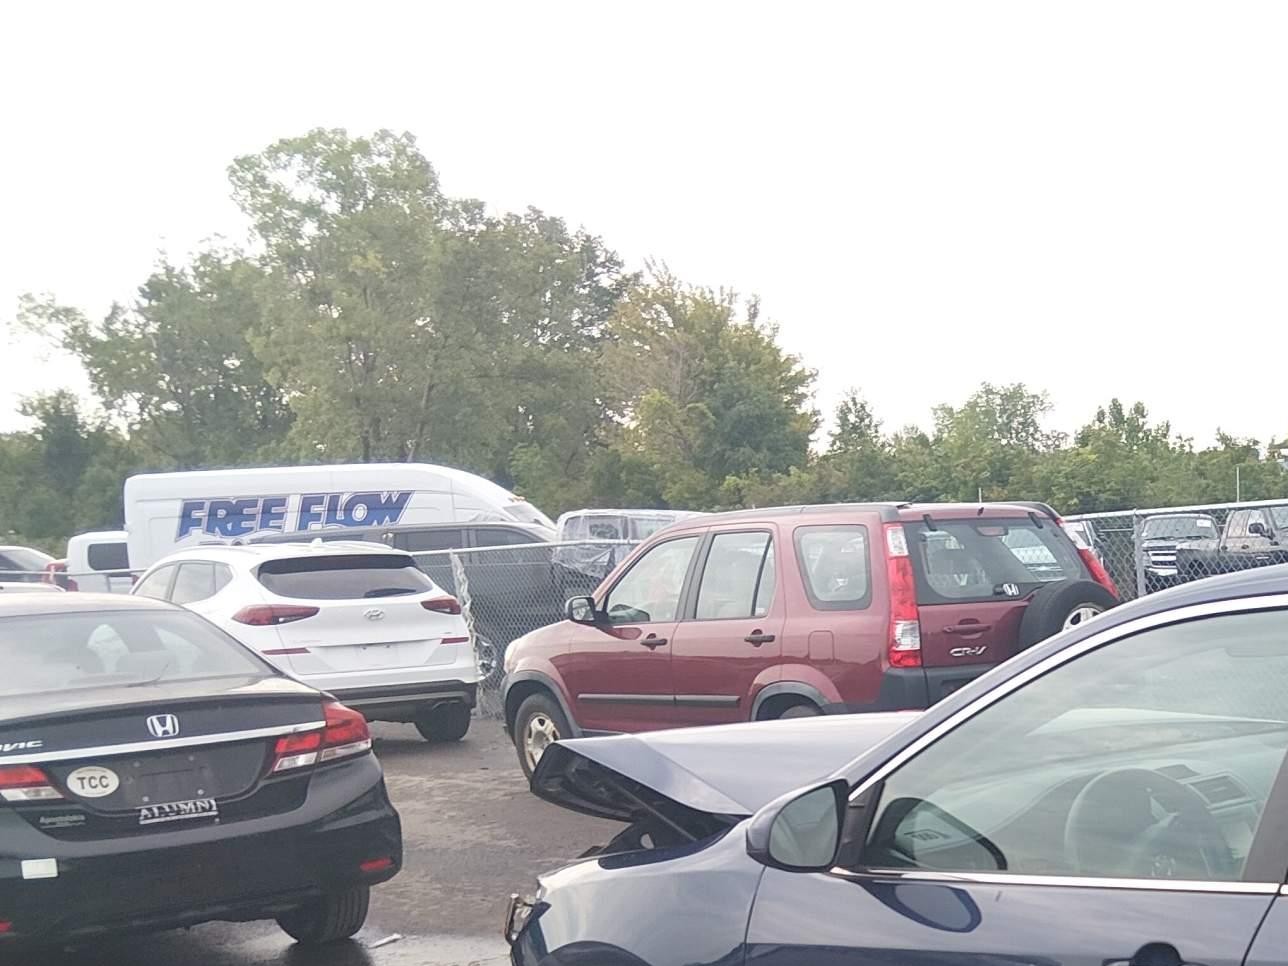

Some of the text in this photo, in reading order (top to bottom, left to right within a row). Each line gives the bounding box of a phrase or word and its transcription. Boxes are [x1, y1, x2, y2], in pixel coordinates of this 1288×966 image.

[176, 490, 415, 541] FREE FLOW
[950, 646, 987, 657] CR-V
[77, 775, 110, 790] TCC
